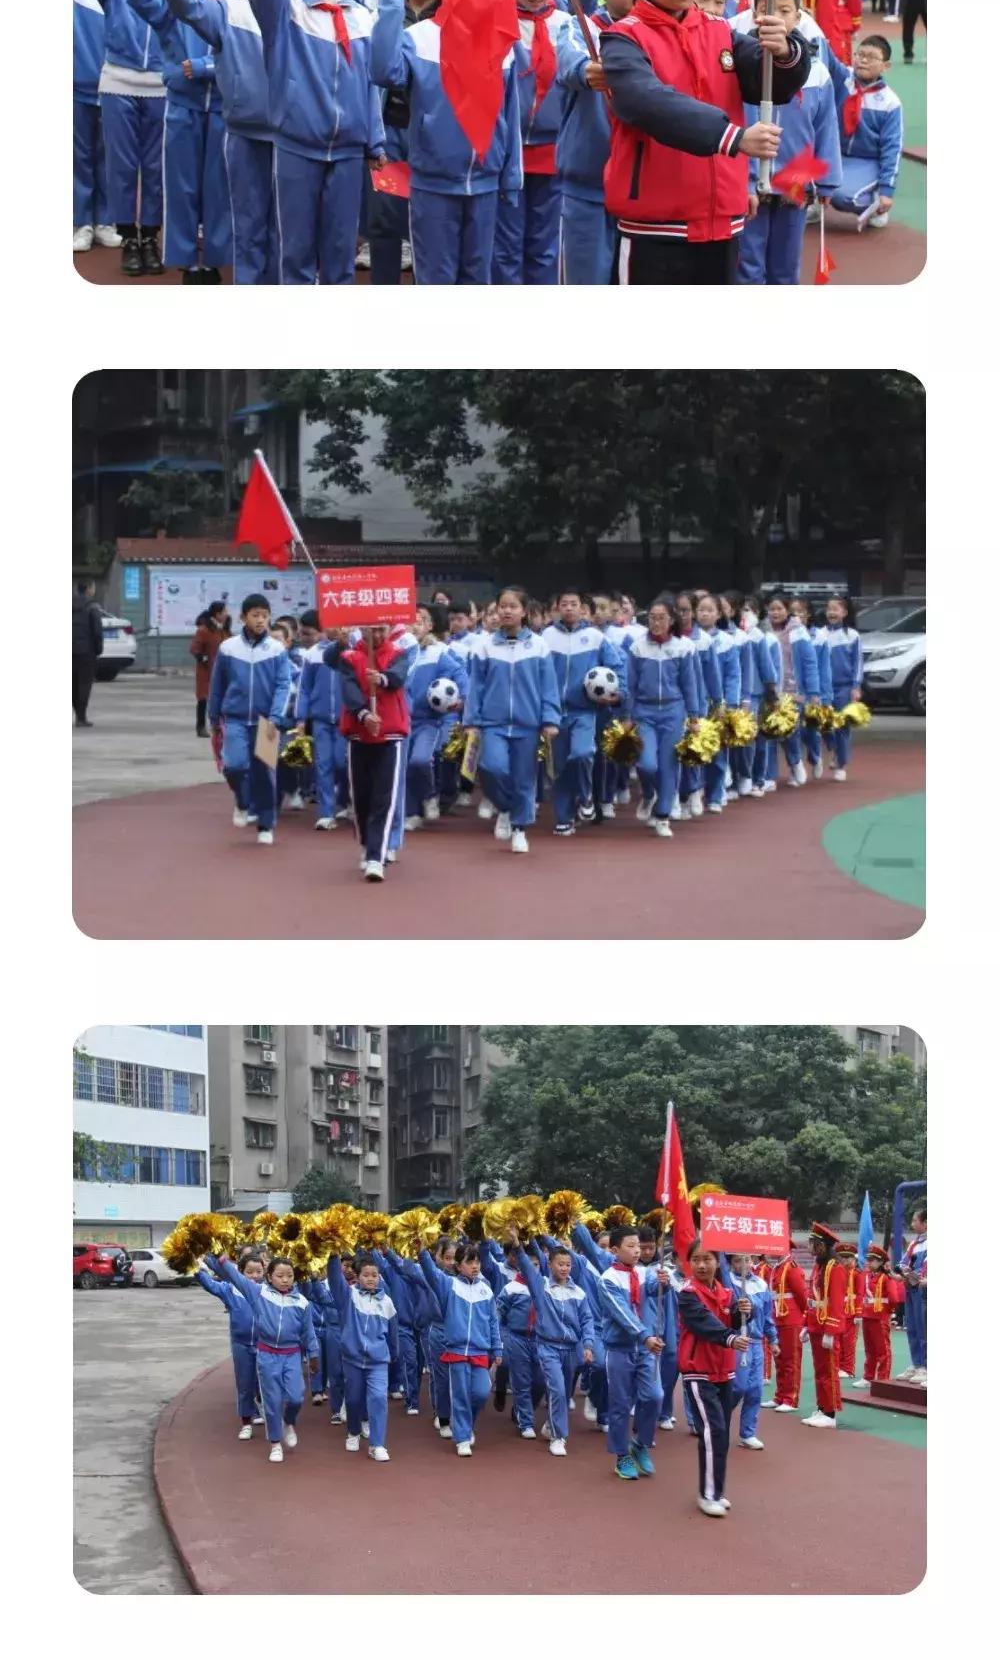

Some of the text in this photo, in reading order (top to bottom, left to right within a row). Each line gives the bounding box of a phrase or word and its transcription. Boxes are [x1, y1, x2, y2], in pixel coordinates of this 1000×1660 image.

[322, 587, 411, 609] 六年级四班
[704, 1214, 785, 1237] 六年级五班
